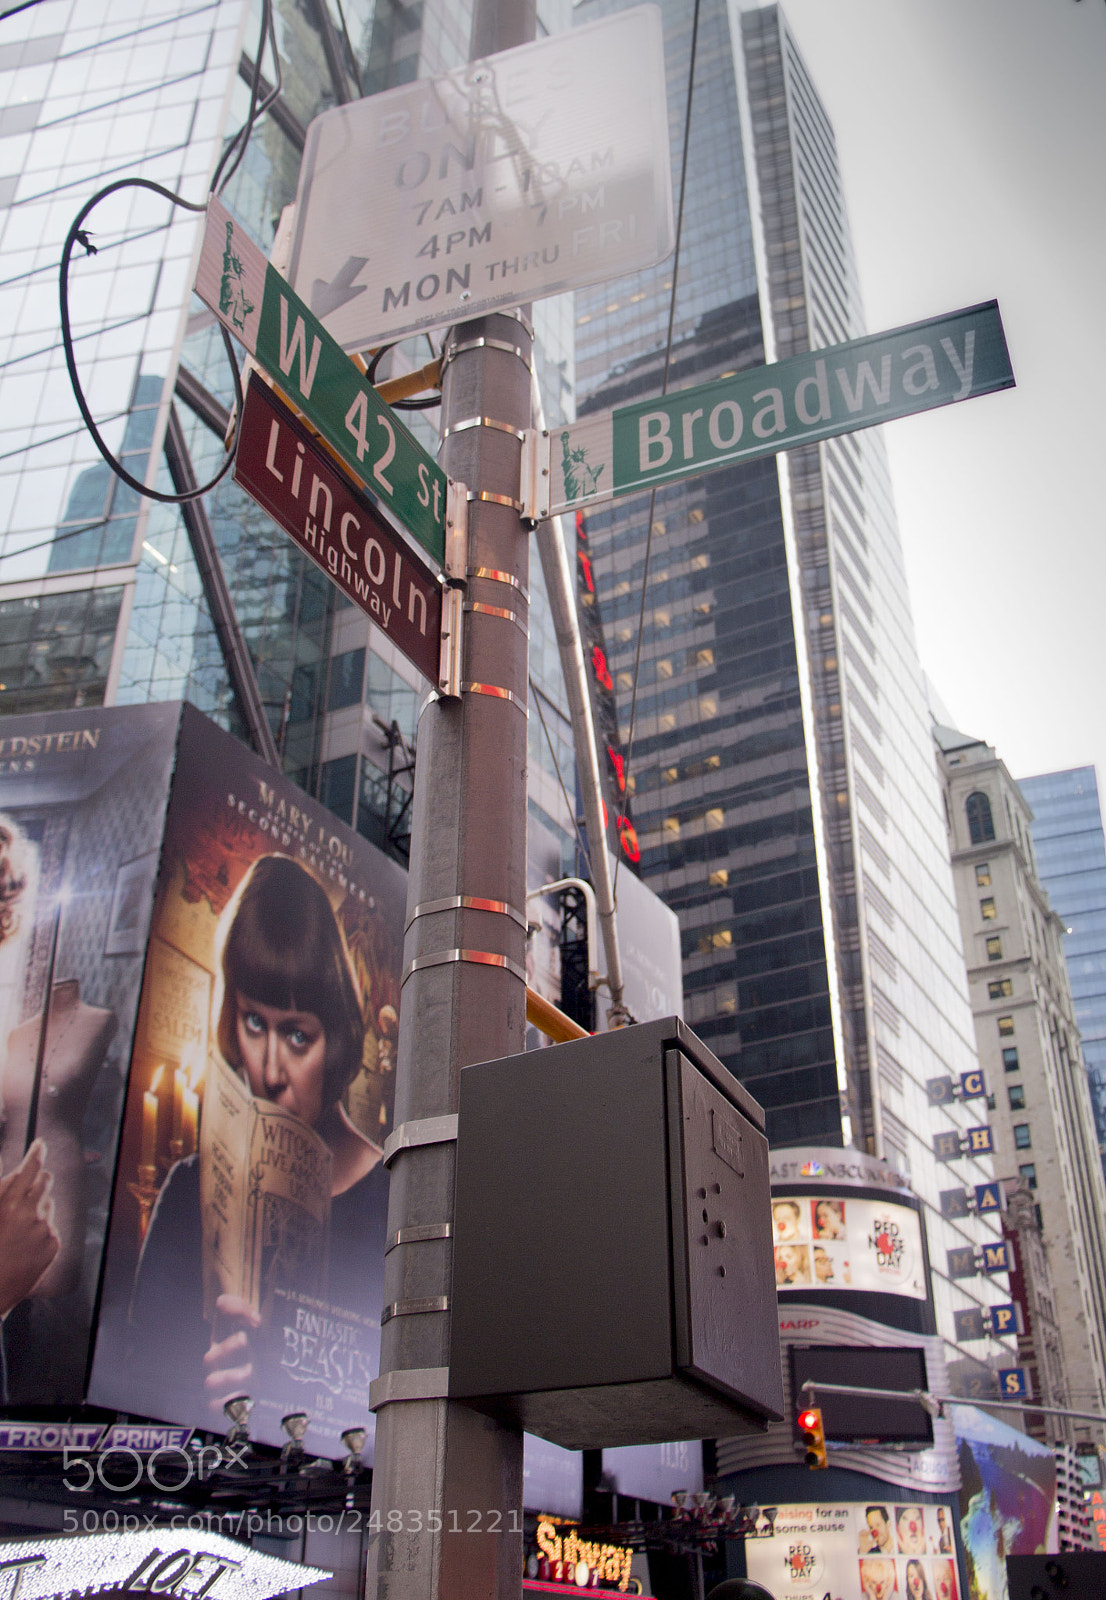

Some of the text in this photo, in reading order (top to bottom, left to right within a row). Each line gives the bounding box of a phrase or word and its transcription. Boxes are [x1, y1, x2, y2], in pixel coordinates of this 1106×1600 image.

[395, 105, 555, 192] ONLY
[412, 187, 484, 227] 7AM
[382, 214, 637, 313] MON THRU FRI
[415, 221, 493, 260] 4PM
[278, 294, 442, 525] W 42 St
[638, 329, 976, 472] Broadway
[265, 419, 428, 637] Lincoln
[304, 515, 393, 630] Highway
[227, 792, 291, 847] SECOND
[258, 780, 354, 867] MARY LOU
[770, 1162, 799, 1179] AST
[873, 1219, 900, 1236] RED
[964, 1074, 1021, 1393] CHAMPS
[876, 1251, 902, 1269] DAY
[280, 1325, 372, 1388] BEASTS
[112, 1429, 184, 1448] PRIME
[778, 1507, 848, 1522] aising for an
[809, 1523, 845, 1533] cause
[789, 1545, 811, 1556] RED
[790, 1568, 812, 1578] DAY
